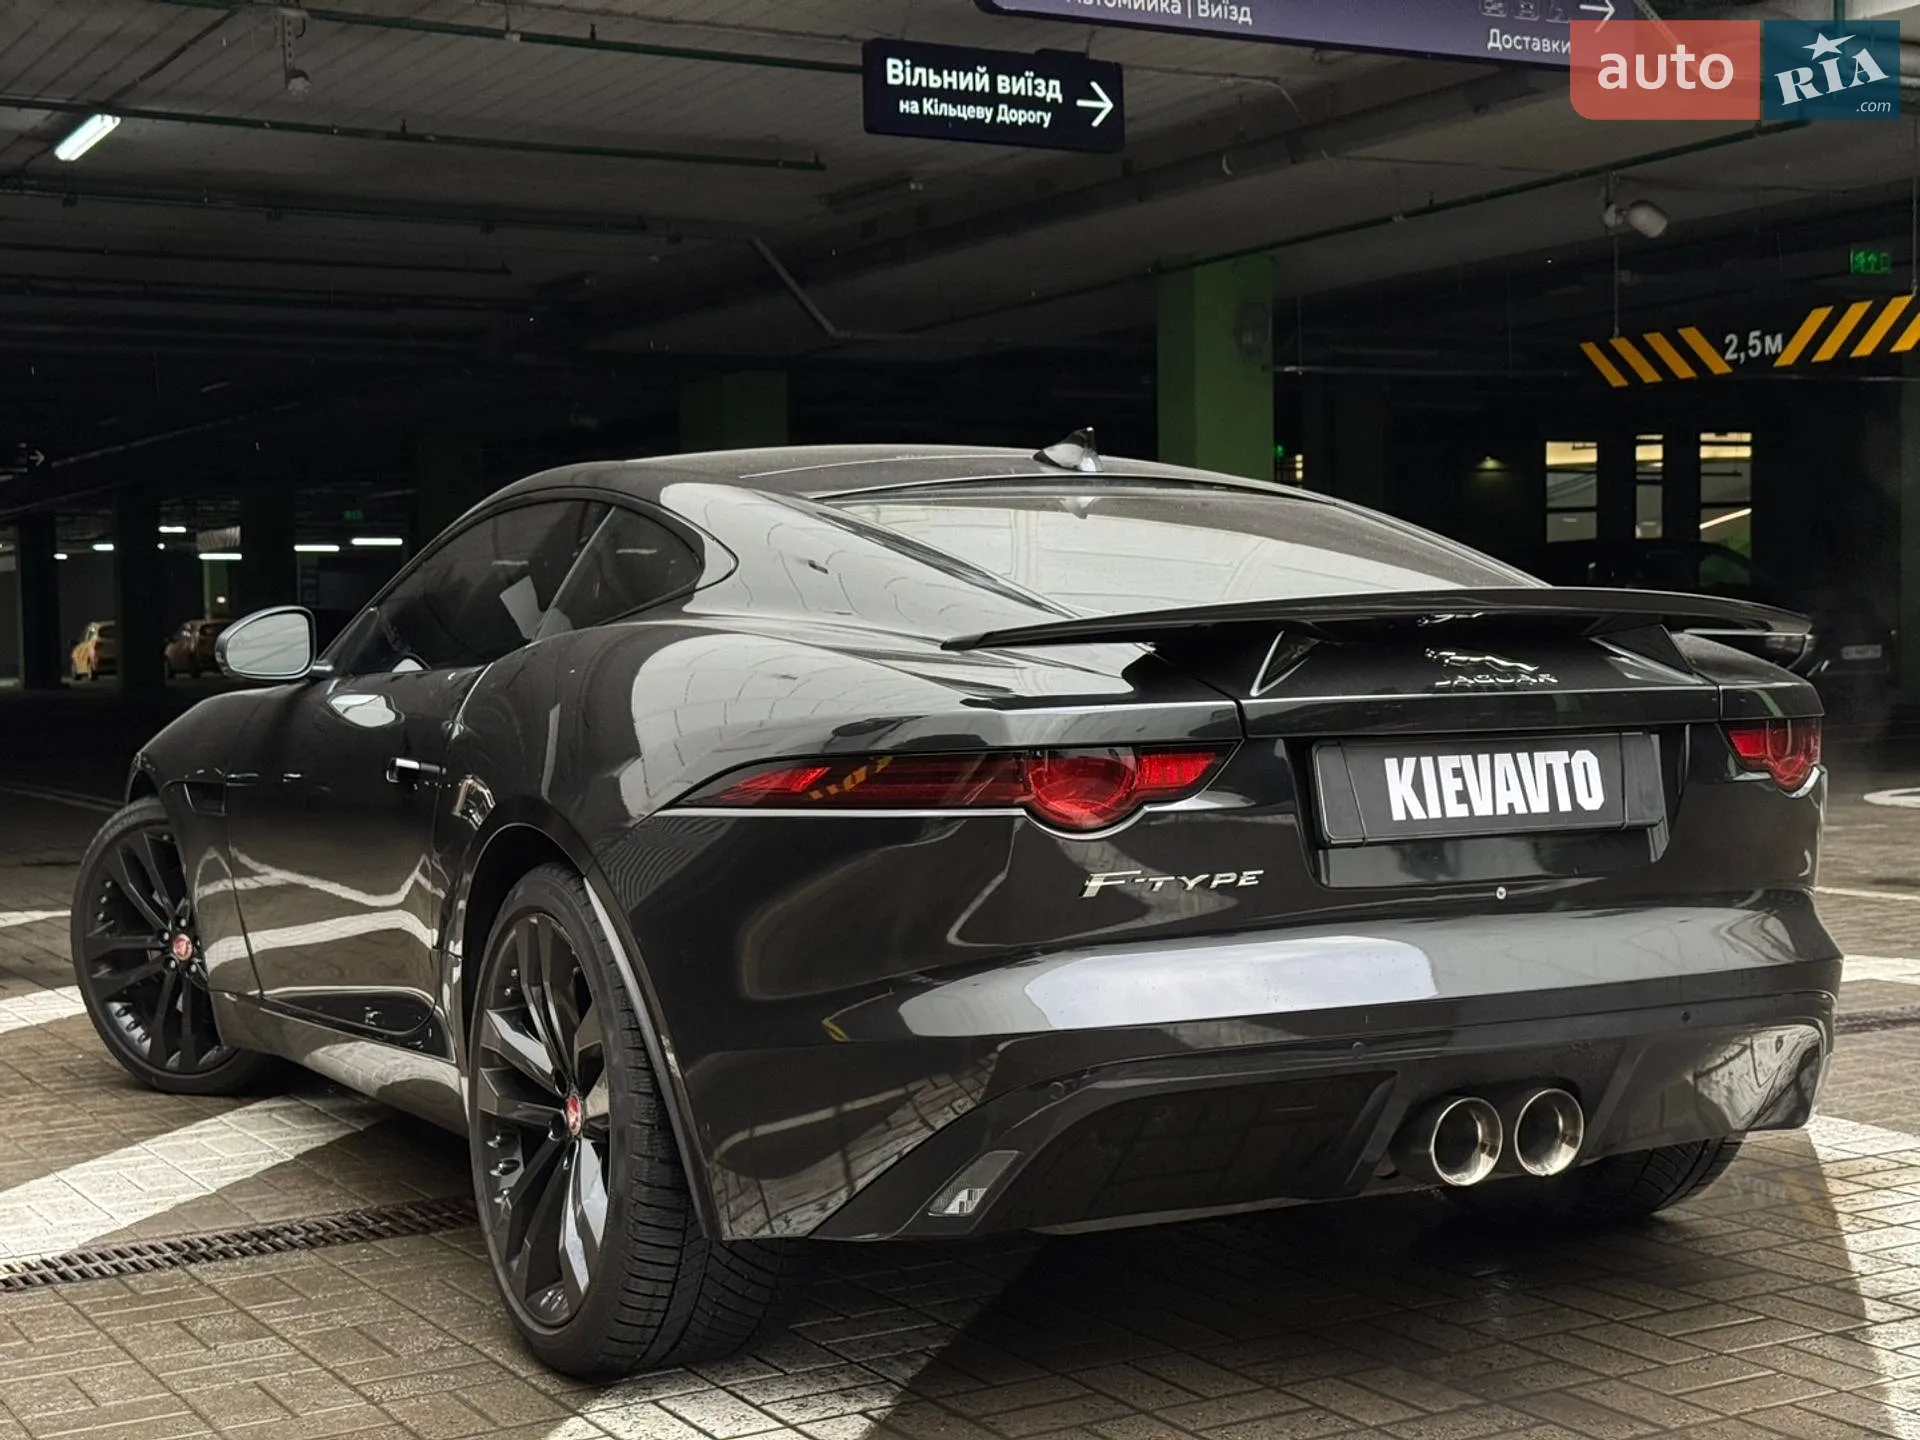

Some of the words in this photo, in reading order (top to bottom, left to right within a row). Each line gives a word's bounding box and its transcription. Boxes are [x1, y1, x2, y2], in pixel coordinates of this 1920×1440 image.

[1066, 0, 1183, 15] томийка
[1197, 0, 1253, 26] Виїзд
[886, 57, 990, 93] Вільний
[997, 71, 1063, 103] виїзд
[899, 99, 919, 115] на
[922, 98, 993, 124] Кільцеву
[996, 103, 1052, 128] Дорогу
[1434, 673, 1559, 688] JAGUAR
[1384, 750, 1605, 821] KIEVAVTO
[1080, 869, 1265, 898] F-TYPE
